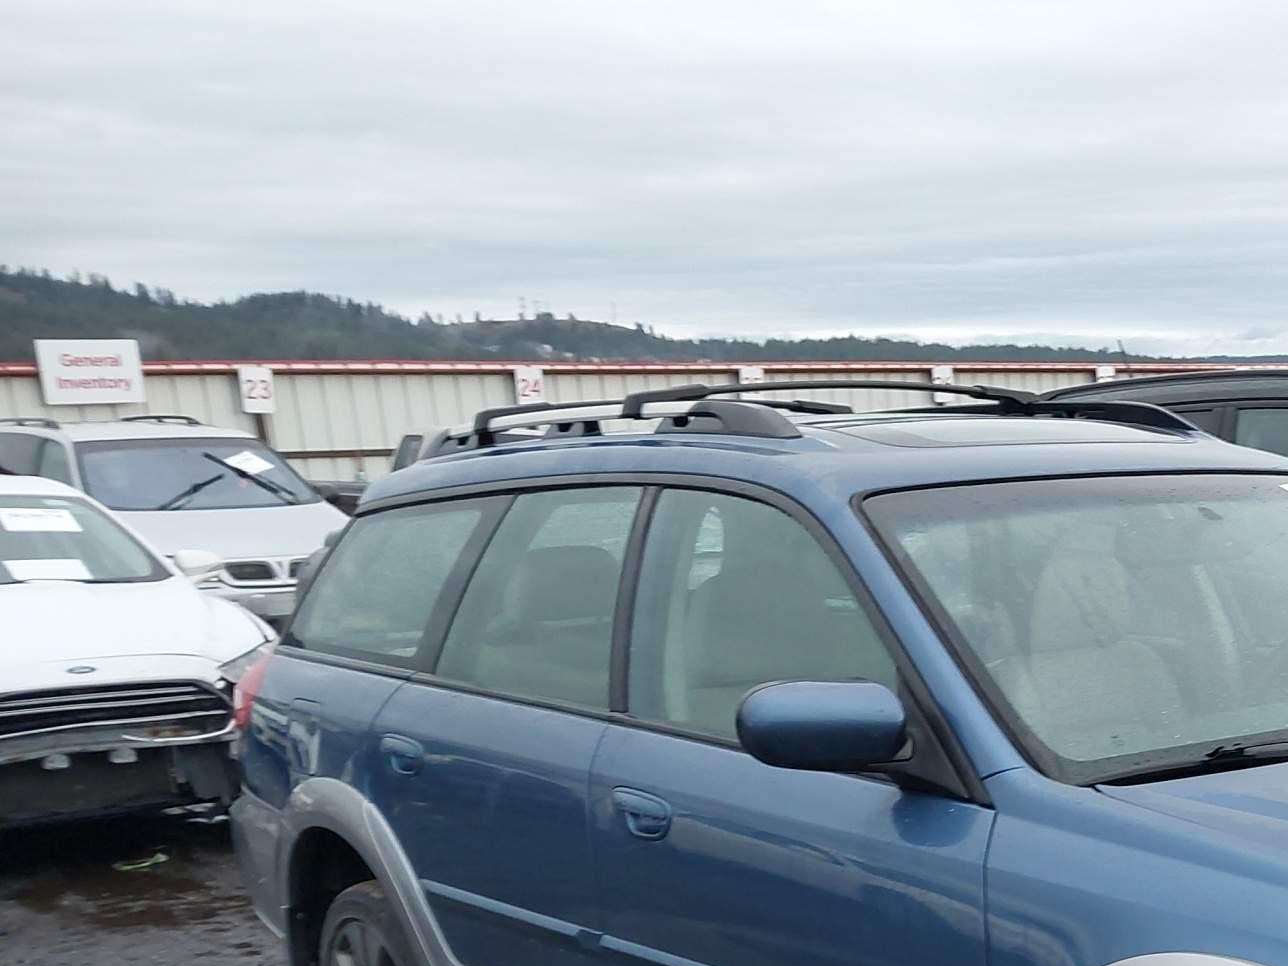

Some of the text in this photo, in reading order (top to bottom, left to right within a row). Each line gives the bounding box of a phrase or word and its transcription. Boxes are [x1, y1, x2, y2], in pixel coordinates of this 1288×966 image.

[60, 353, 122, 368] General
[57, 377, 131, 391] Inventory
[245, 379, 272, 400] 23
[520, 378, 541, 398] 24
